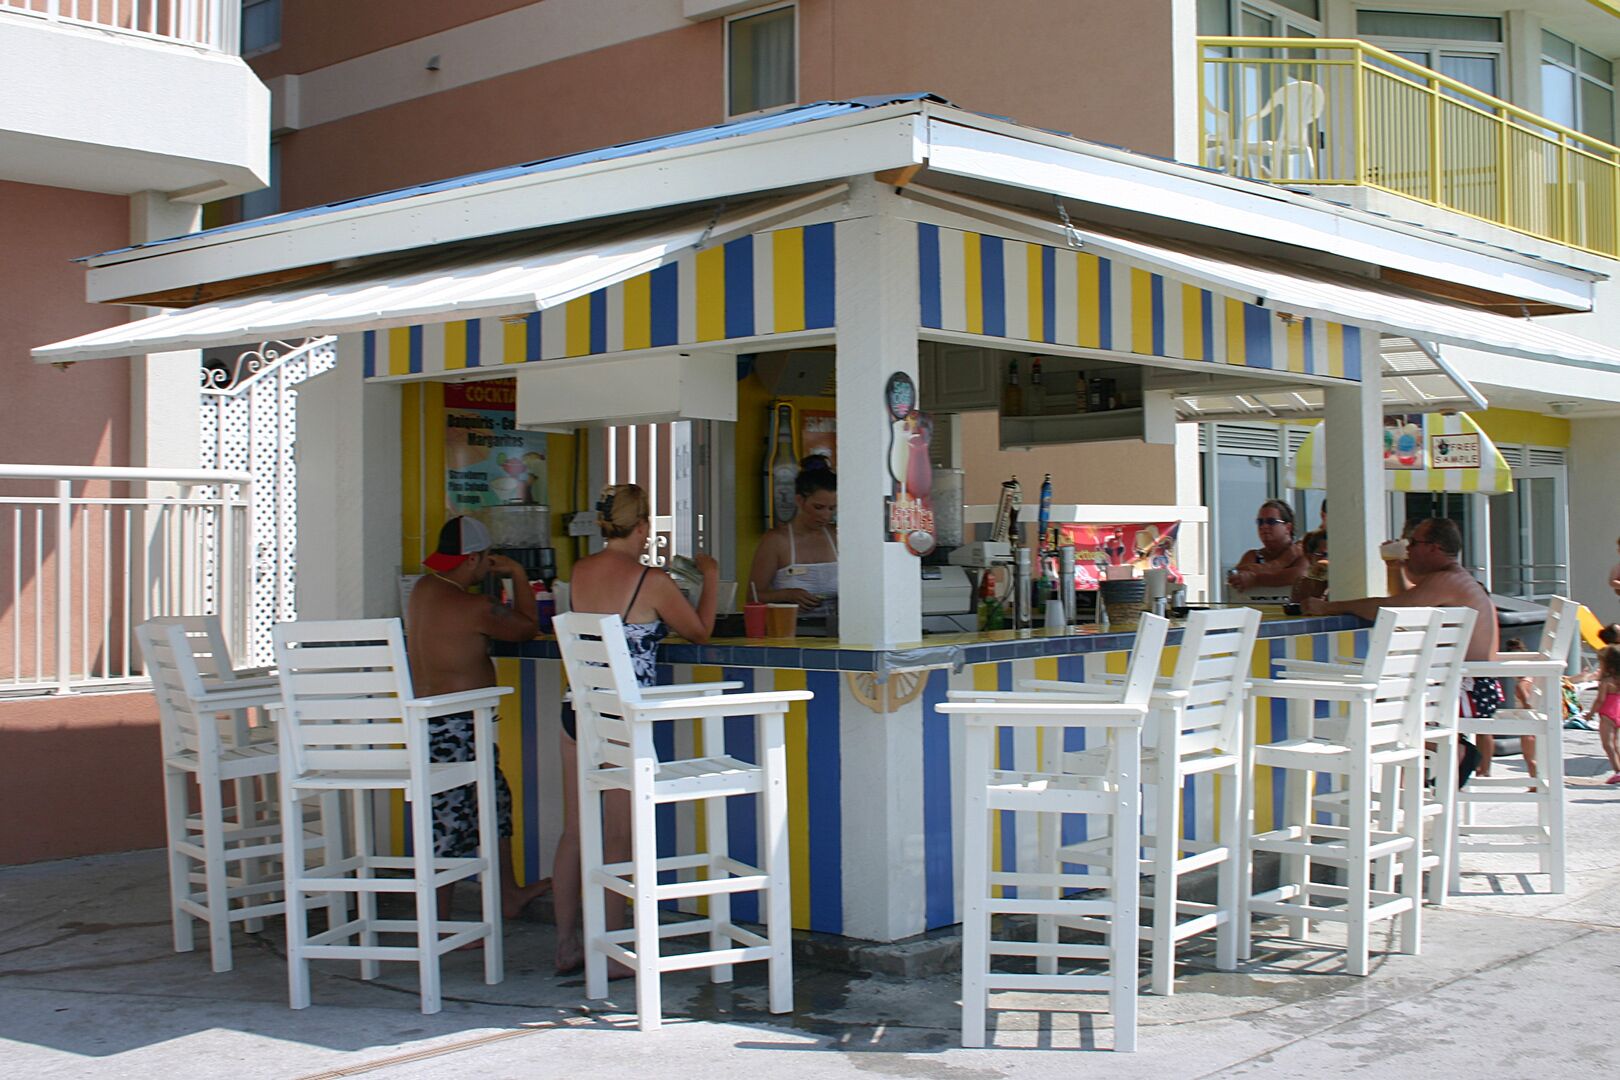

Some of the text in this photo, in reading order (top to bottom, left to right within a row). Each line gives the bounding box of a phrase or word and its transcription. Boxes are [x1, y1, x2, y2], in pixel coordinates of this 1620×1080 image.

[468, 433, 524, 447] Margaritas
[1451, 443, 1477, 451] FREE
[1435, 455, 1477, 463] SAMPLE
